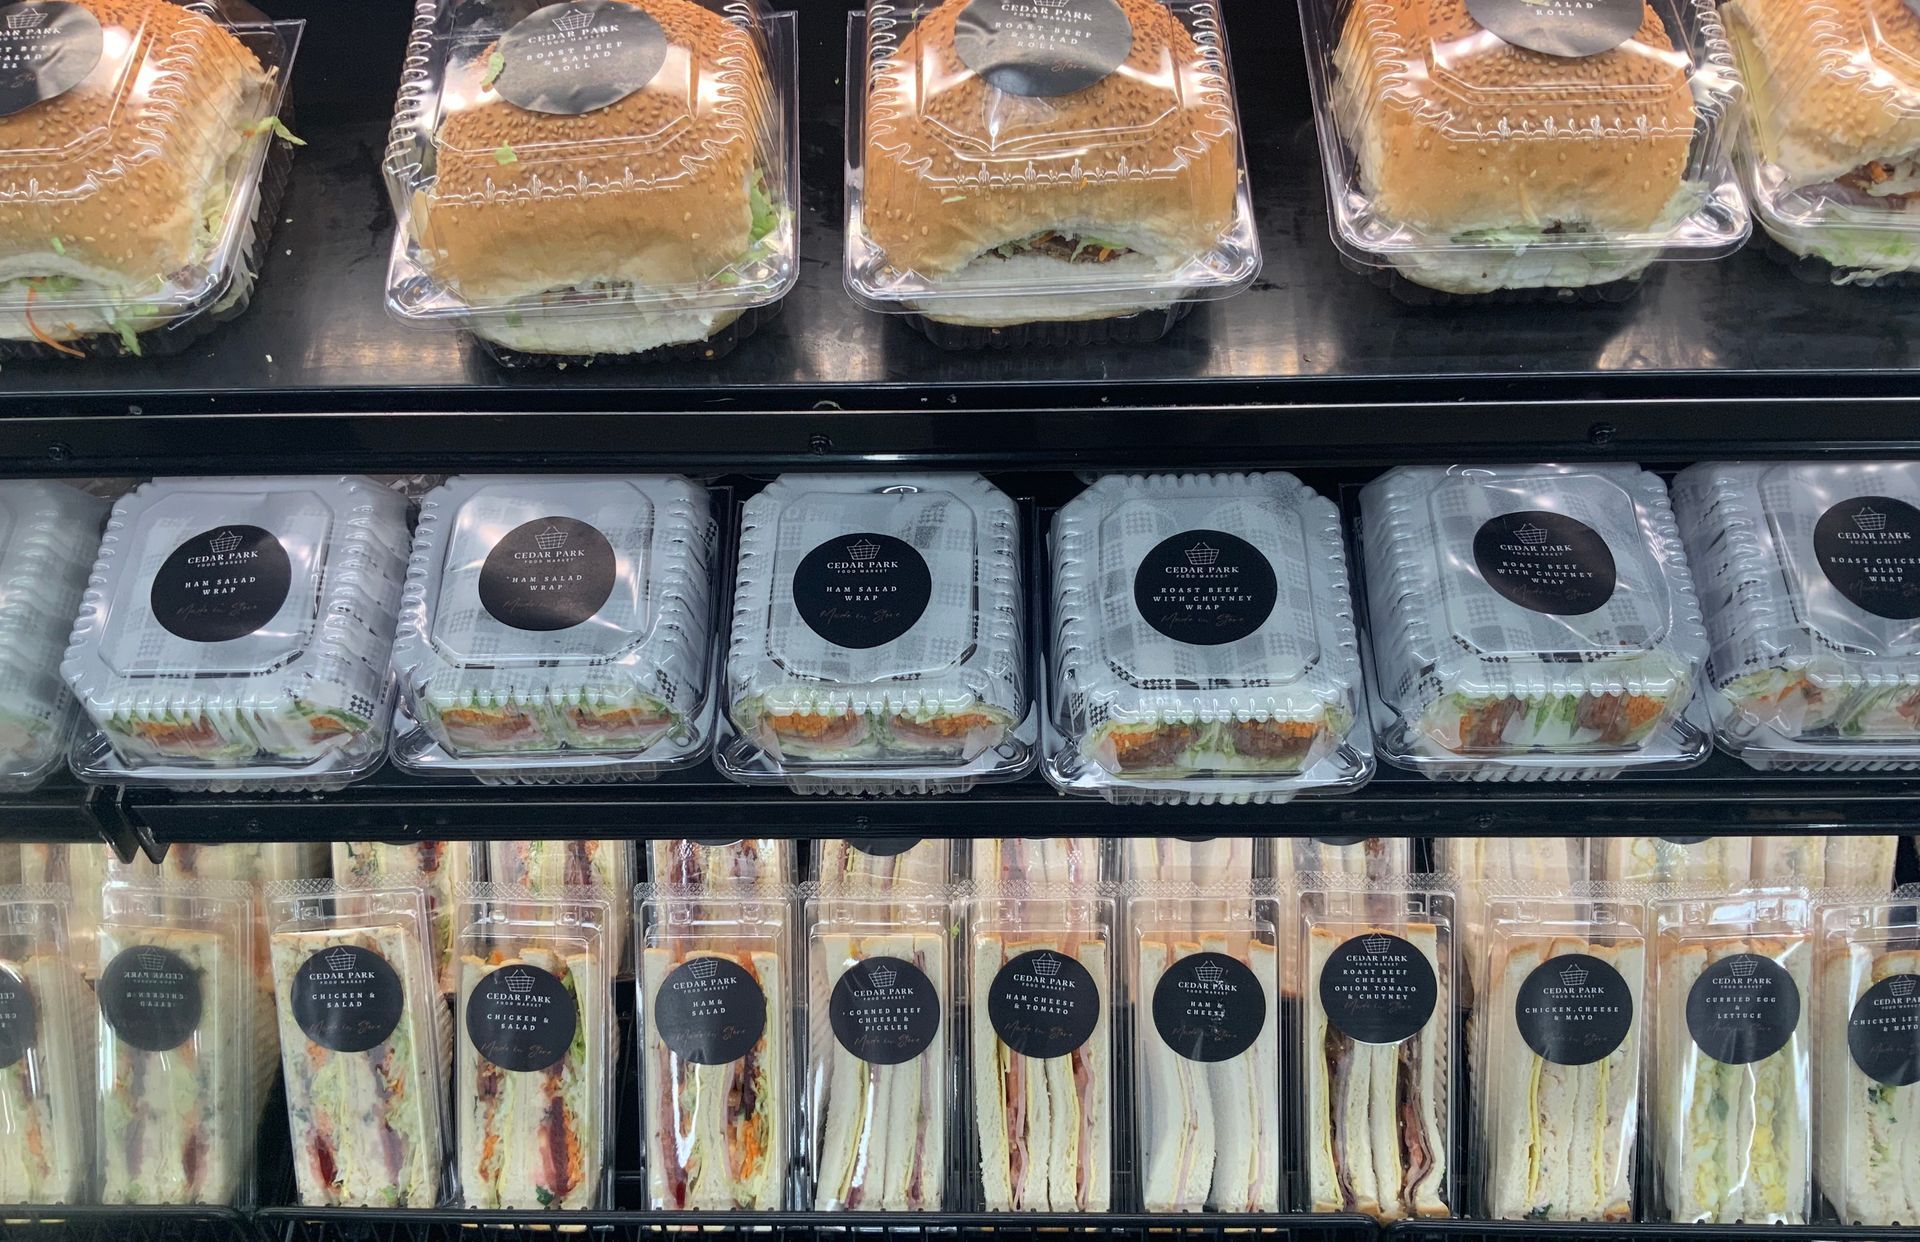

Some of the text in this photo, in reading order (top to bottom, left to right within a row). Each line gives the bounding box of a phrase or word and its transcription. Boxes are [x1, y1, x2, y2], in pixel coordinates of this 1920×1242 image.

[1001, 4, 1093, 21] CEDAR PARK
[528, 25, 619, 44] CEDAR PARK
[995, 22, 1091, 38] ROAST BEEF
[1029, 33, 1077, 45] SALAD
[1017, 41, 1055, 50] ROLL
[527, 41, 622, 61] ROAST BEEF
[562, 52, 611, 63] SALAD
[553, 63, 590, 72] ROLL
[188, 551, 258, 564] CEDAR PARK
[217, 577, 255, 585] SALAD
[310, 972, 344, 980] CEDAR
[1014, 974, 1075, 988] CEDAR PARK
[673, 977, 737, 990] CEDAR PARK
[525, 995, 551, 1003] PARK
[1034, 997, 1074, 1007] CHEESE
[692, 1008, 725, 1016] SALAD
[1027, 1004, 1068, 1014] TOMATO
[487, 1014, 536, 1022] CHICKEN
[1854, 1017, 1897, 1025] CHICKEN
